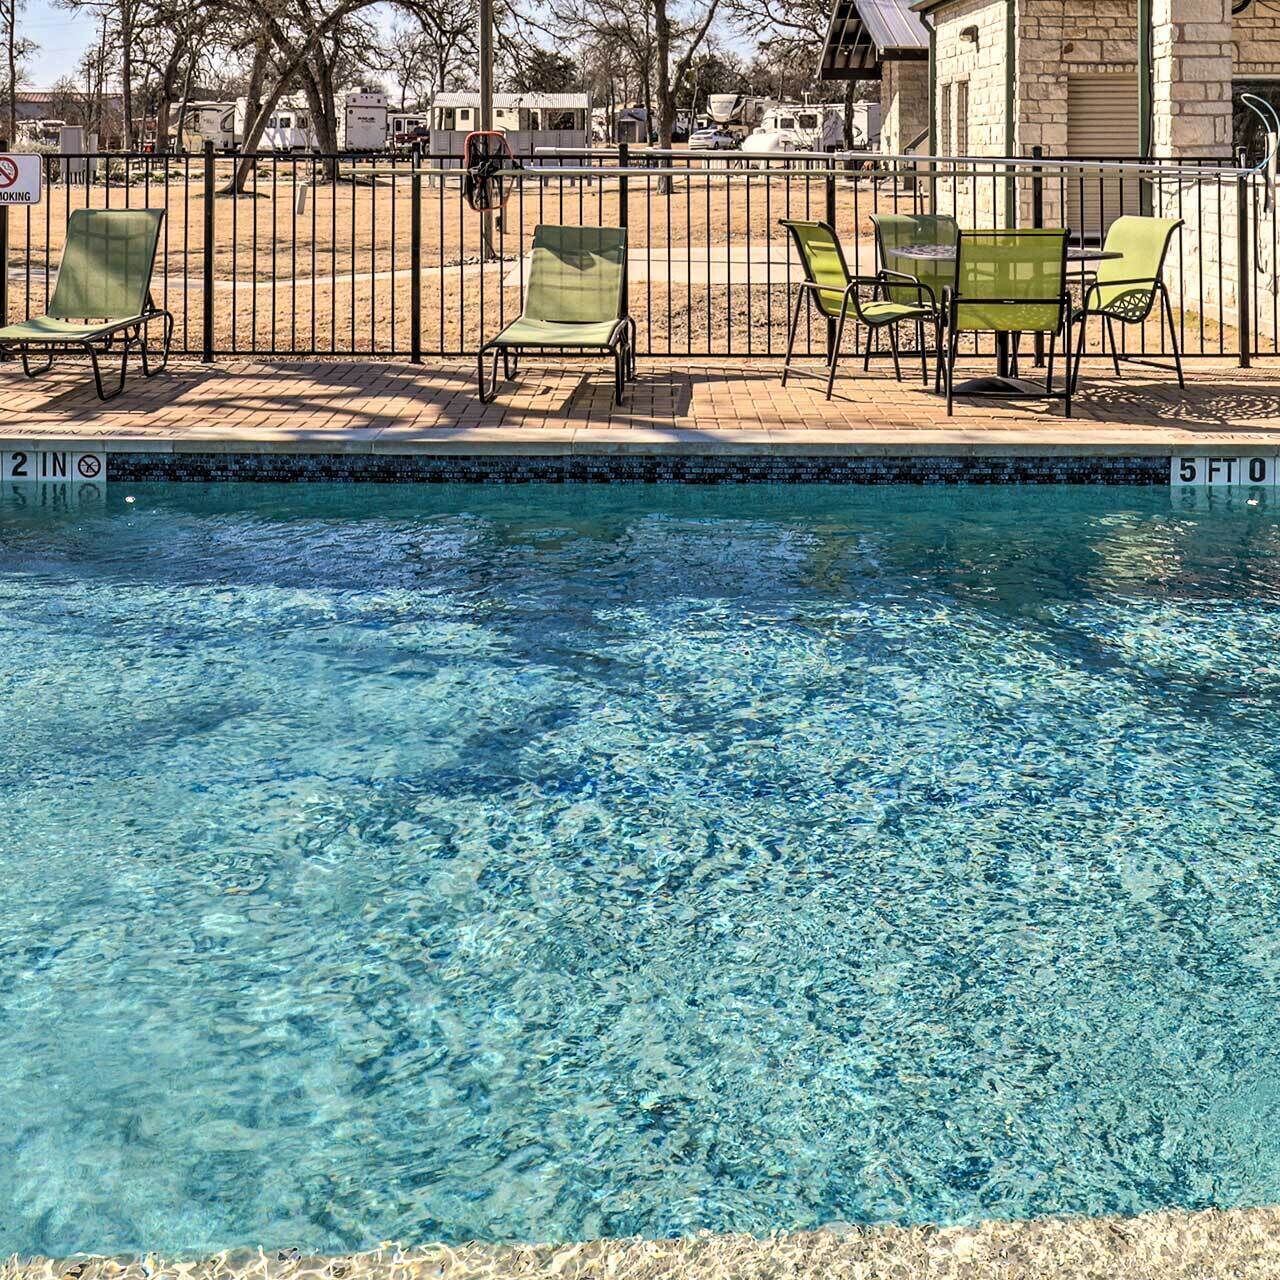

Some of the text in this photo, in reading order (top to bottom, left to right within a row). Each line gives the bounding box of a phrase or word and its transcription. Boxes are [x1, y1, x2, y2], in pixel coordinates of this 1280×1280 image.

[11, 452, 28, 476] 2
[42, 452, 67, 477] IN
[1179, 458, 1197, 482] 5
[1208, 458, 1237, 482] FT
[1249, 458, 1266, 482] 0
